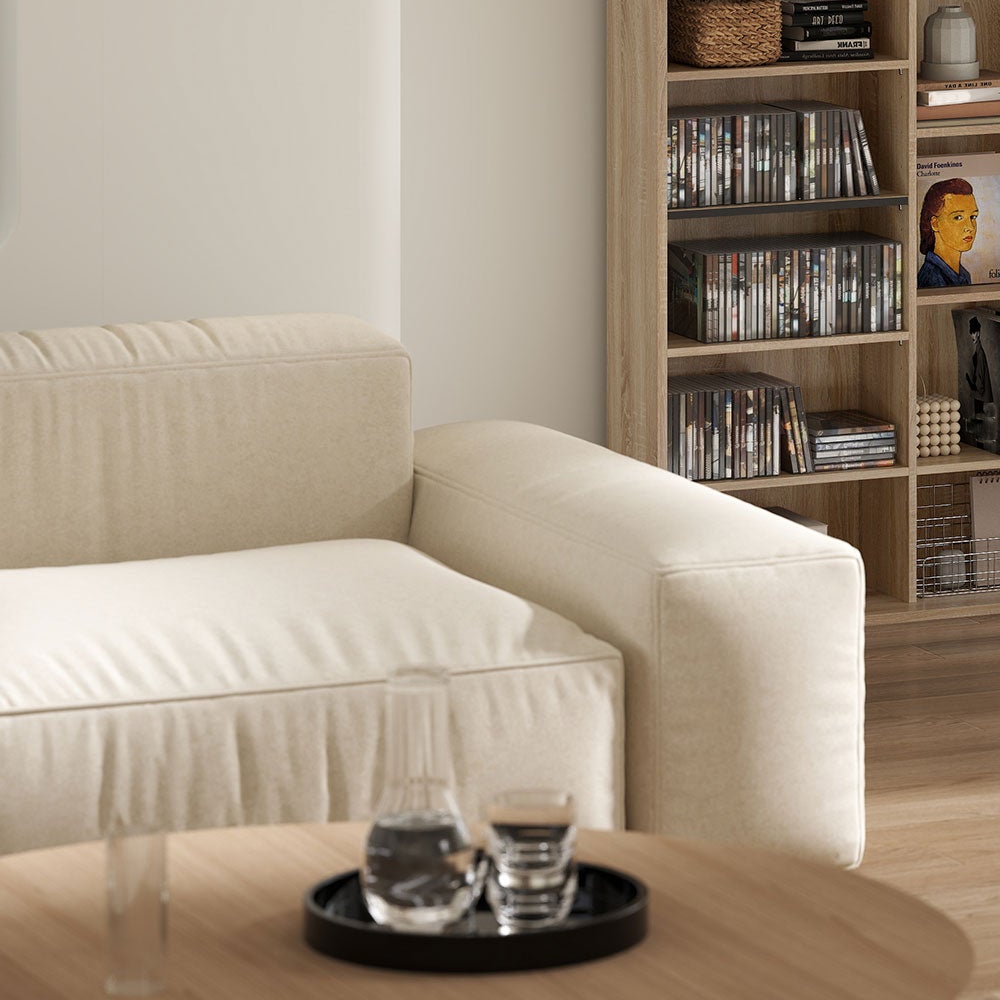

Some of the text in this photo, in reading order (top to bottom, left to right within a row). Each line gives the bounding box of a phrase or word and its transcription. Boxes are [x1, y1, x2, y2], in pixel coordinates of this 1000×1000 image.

[811, 14, 844, 26] ART DECO
[916, 161, 963, 170] David Foenkinos
